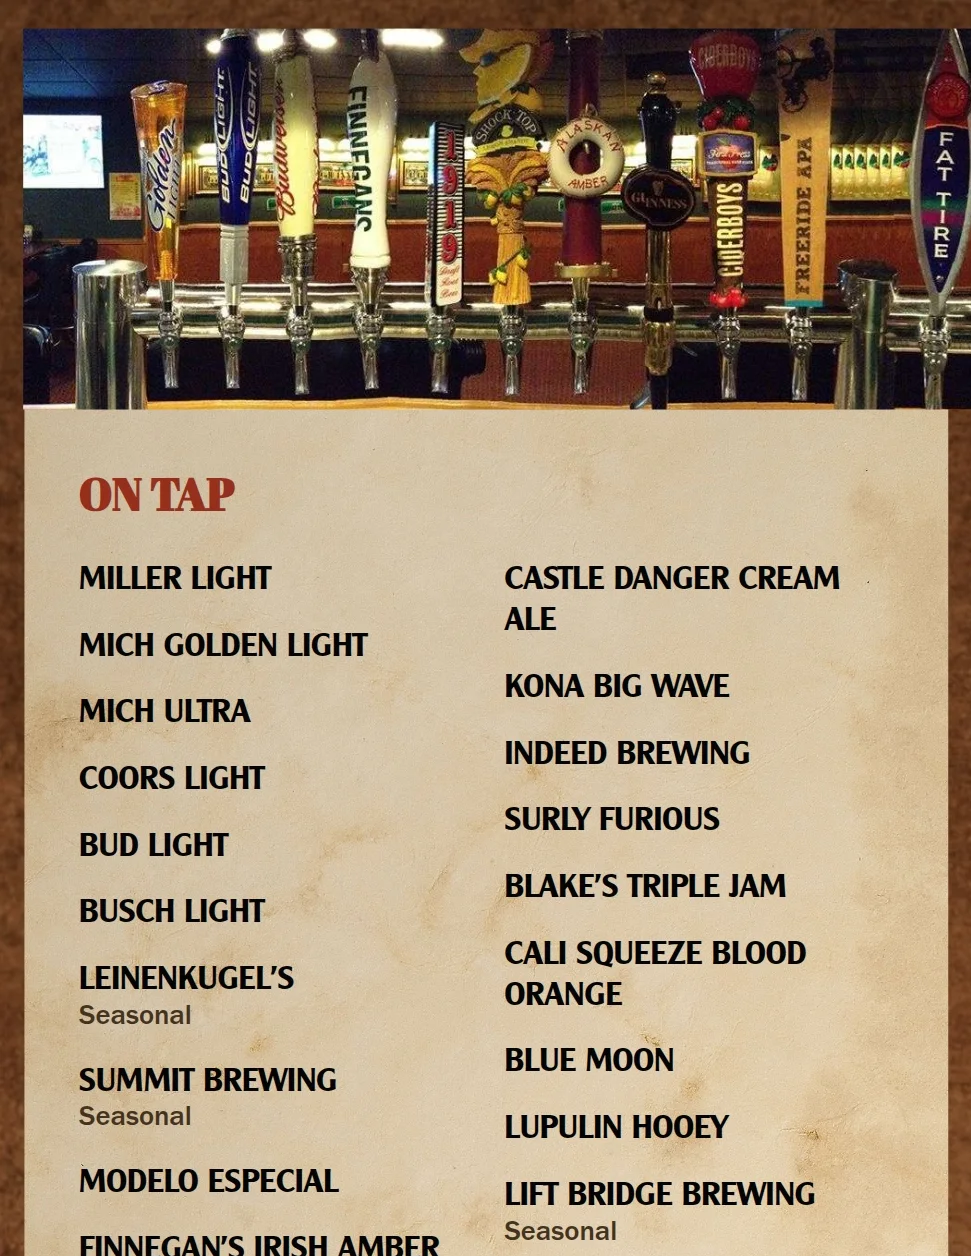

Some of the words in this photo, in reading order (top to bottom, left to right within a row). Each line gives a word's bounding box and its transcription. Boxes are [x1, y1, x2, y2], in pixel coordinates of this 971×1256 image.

[214, 67, 227, 144] LIGHT
[245, 64, 258, 140] LIGHT
[475, 109, 512, 143] SHOCK
[517, 109, 537, 134] TOP
[556, 120, 622, 153] ALASKAN
[273, 79, 296, 222] Budweiser
[799, 136, 812, 180] APA
[935, 131, 955, 182] FAT
[146, 117, 177, 232] Golden
[218, 152, 231, 204] BUD
[239, 151, 254, 204] BUD
[567, 176, 609, 190] AMBER
[441, 128, 458, 264] 1919
[716, 181, 744, 277] CIDERBOYS
[933, 191, 952, 258] TIRE
[795, 186, 812, 295] FREERIDE
[80, 477, 142, 511] ON
[151, 478, 235, 511] TAP
[80, 566, 182, 589] MILLER
[192, 566, 272, 589] LIGHT
[505, 566, 604, 589] CASTLE
[615, 566, 730, 589] DANGER
[739, 566, 839, 589] CREAM
[504, 607, 556, 630] ALE
[80, 633, 153, 656] MICH
[164, 633, 276, 656] GOLDEN
[288, 633, 368, 656] LIGHT
[506, 674, 585, 697] KONA
[595, 674, 641, 697] BIG
[650, 674, 730, 697] WAVE
[80, 699, 153, 722] MICH
[165, 699, 251, 722] ULTRA
[506, 741, 607, 764] INDEED
[618, 741, 749, 764] BREWING
[80, 766, 175, 789] COORS
[186, 766, 266, 789] LIGHT
[505, 807, 592, 830] SURLY
[600, 807, 720, 830] FURIOUS
[80, 833, 138, 856] BUD
[149, 833, 229, 856] LIGHT
[506, 874, 618, 897] BLAKE'S
[626, 874, 720, 897] TRIPLE
[729, 874, 786, 897] JAM
[80, 899, 174, 922] BUSCH
[186, 899, 266, 922] LIGHT
[505, 941, 566, 964] CALI
[577, 941, 702, 967] SQUEEZE
[713, 941, 806, 964] BLOOD
[80, 966, 294, 989] LEINENKUGEL'S
[505, 982, 622, 1005] ORANGE
[79, 1005, 190, 1024] Seasonal
[506, 1048, 576, 1071] BLUE
[586, 1048, 673, 1071] MOON
[79, 1068, 195, 1091] SUMMIT
[205, 1068, 336, 1091] BREWING
[506, 1115, 621, 1138] LUPULIN
[633, 1115, 730, 1138] HOOEY
[80, 1169, 198, 1192] MODELO
[209, 1169, 339, 1192] ESPECIAL
[506, 1182, 559, 1205] LIFT
[569, 1182, 673, 1205] BRIDGE
[683, 1182, 815, 1205] BREWING
[505, 1221, 616, 1240] Seasonal
